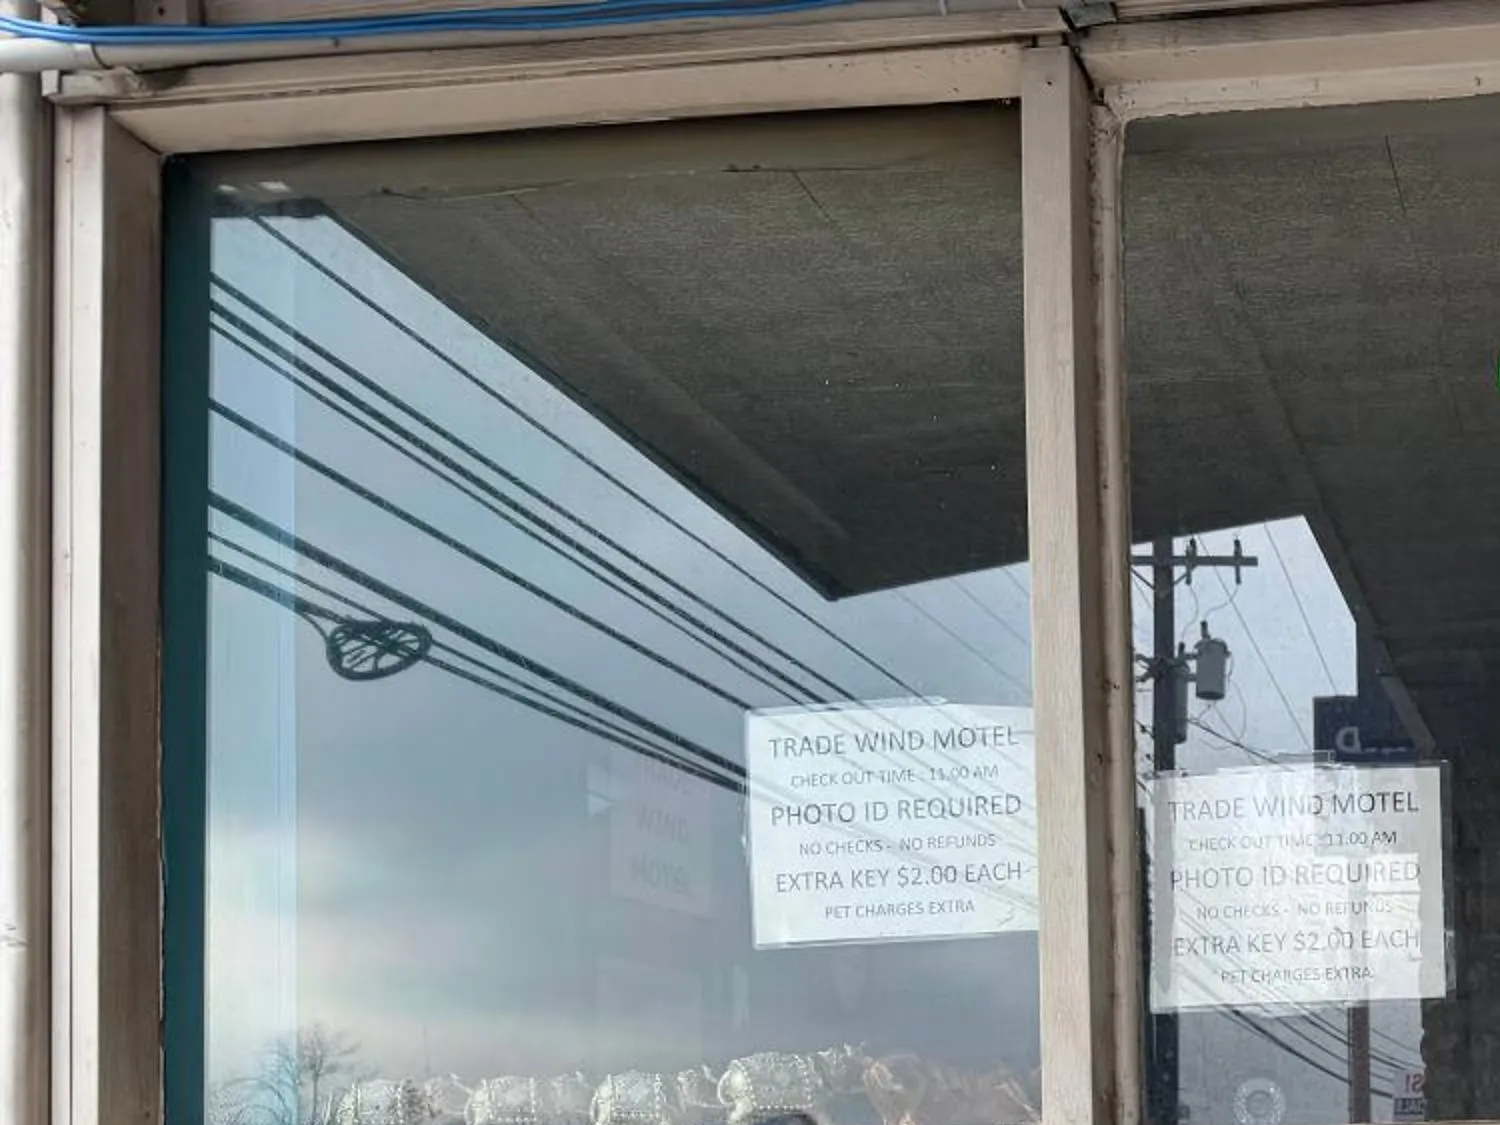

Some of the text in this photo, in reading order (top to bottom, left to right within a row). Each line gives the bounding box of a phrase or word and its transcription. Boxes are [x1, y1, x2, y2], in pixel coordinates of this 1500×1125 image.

[769, 725, 1019, 758] TRADE WIND MOTEL
[791, 772, 837, 789] CHECK
[842, 770, 872, 785] OUT
[973, 763, 999, 780] AM
[771, 793, 1022, 827] PHOTO ID REQUIRED
[1168, 791, 1419, 823] TRADE WIND MOTEL
[799, 842, 821, 856] NO
[826, 839, 883, 856] CHECKS
[900, 836, 923, 851] NO
[928, 832, 996, 849] REFUNDS
[1189, 836, 1235, 852] CHECK
[1371, 830, 1398, 845] AM
[776, 861, 1022, 893] EXTRA KEY $2.00 EACH
[1171, 861, 1421, 891] PHOTO ID REQUIRED
[825, 898, 975, 920] PET CHARGES EXTRA
[1197, 905, 1219, 920] NO
[1298, 901, 1320, 916] NO
[1175, 928, 1420, 956] EXTRA KEY $2.00 EACH
[1325, 965, 1372, 981] EXTRA
